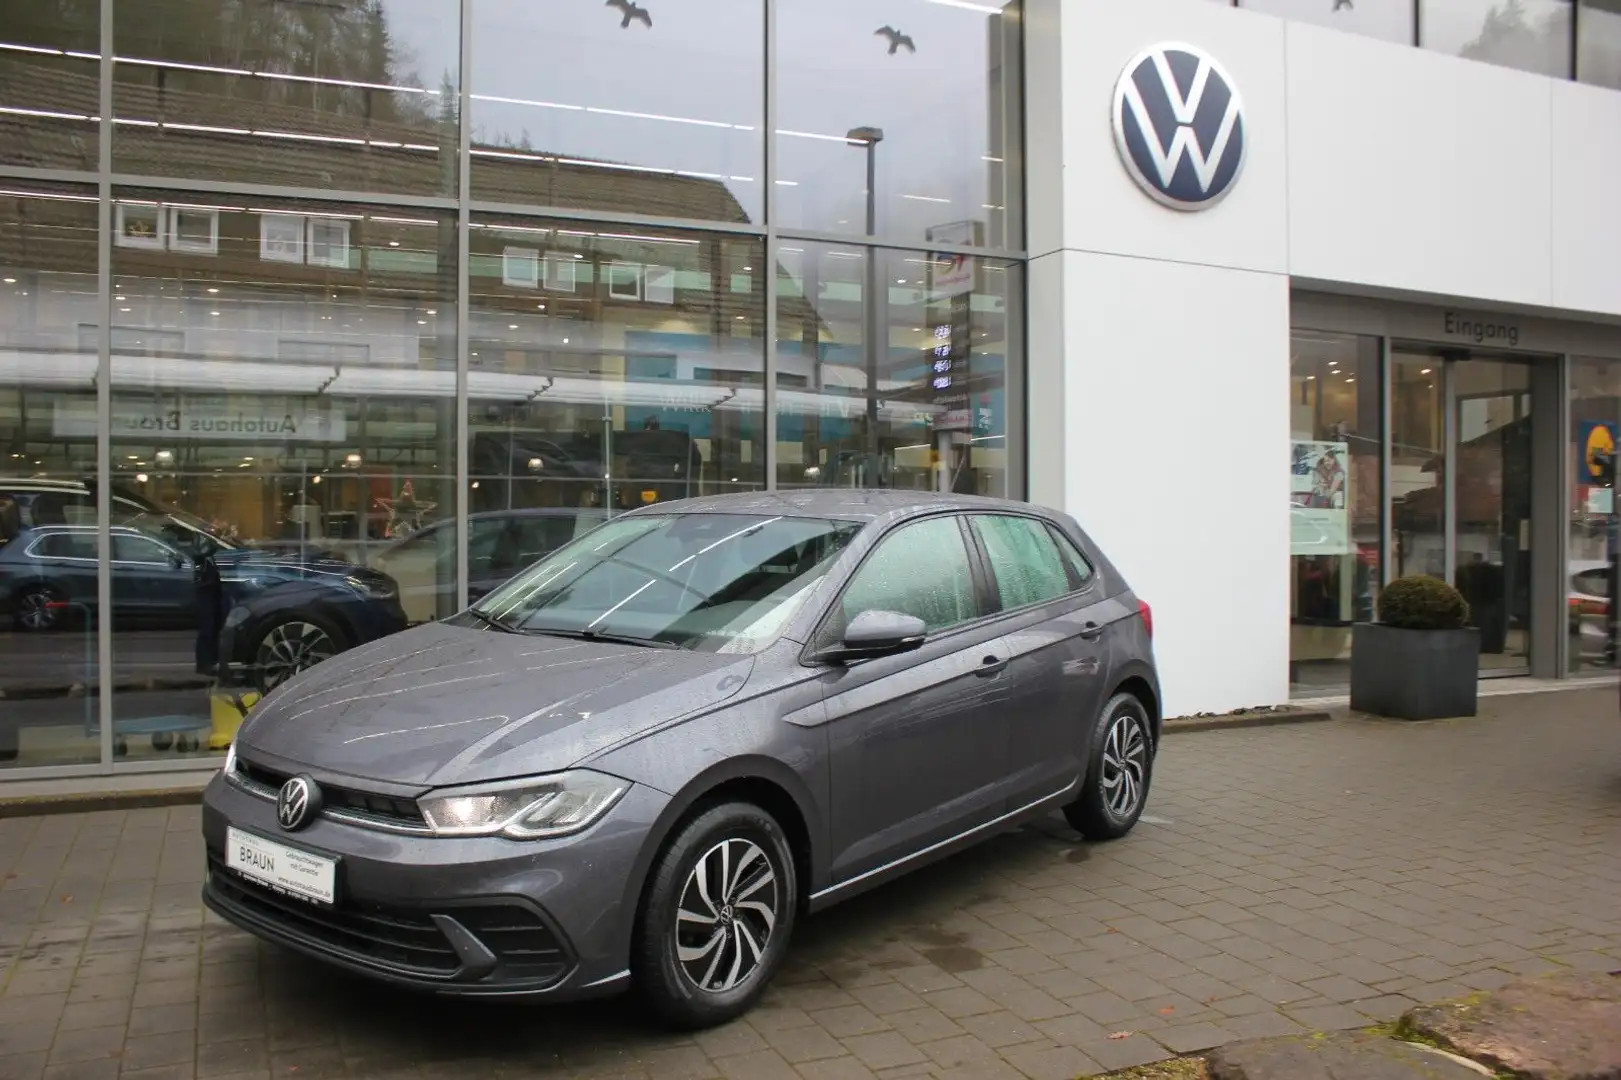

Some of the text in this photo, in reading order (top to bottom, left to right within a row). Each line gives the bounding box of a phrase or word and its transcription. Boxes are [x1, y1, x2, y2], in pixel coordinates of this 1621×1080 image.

[1115, 45, 1244, 200] VW
[1444, 312, 1519, 346] Eingang
[239, 846, 275, 871] BRAUN
